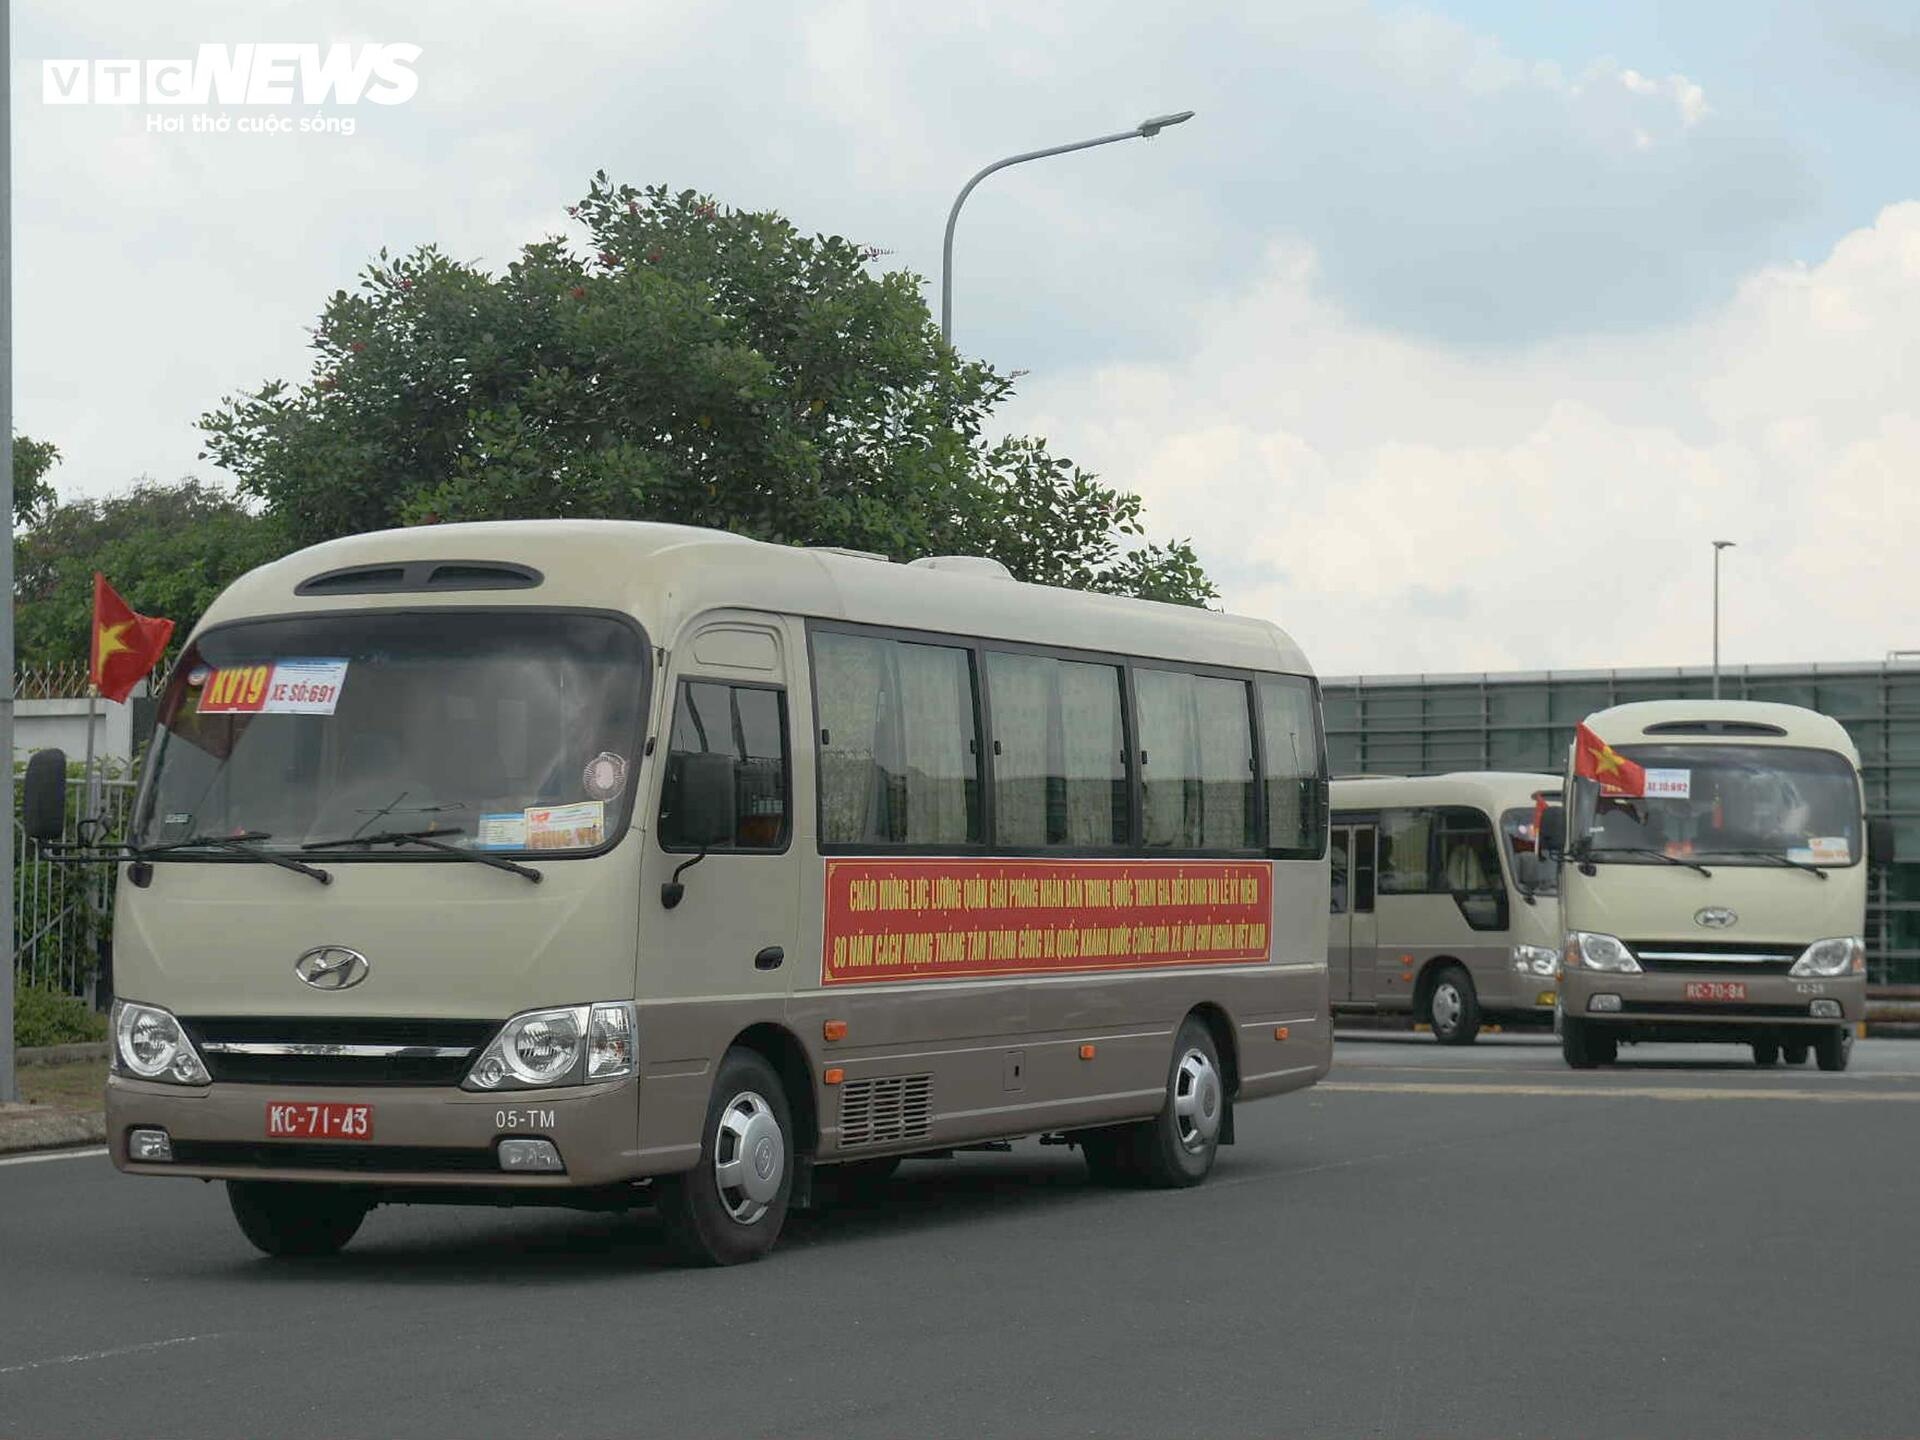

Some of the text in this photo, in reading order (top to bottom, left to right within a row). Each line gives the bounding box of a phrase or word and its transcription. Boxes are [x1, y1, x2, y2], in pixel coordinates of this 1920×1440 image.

[208, 666, 268, 704] KV19
[271, 684, 289, 701] XE
[849, 873, 877, 911] CHÀO
[879, 873, 909, 910] MỪNG
[911, 876, 929, 917] LỰC
[931, 876, 961, 917] LƯỢNG
[963, 873, 988, 912] QUÂN
[990, 869, 1008, 909] GIẢI
[1040, 873, 1064, 908] NHÂN
[1066, 873, 1083, 908] DÂN
[1084, 878, 1111, 908] TRUNG
[833, 935, 847, 969] 80
[848, 928, 875, 967] NĂM
[875, 927, 903, 966] CÁCH
[903, 932, 934, 971] MẠNG
[935, 924, 966, 963] THÁNG
[968, 924, 987, 961] TÁM
[1019, 923, 1042, 959] CÔNG
[1044, 922, 1055, 958] VÀ
[270, 1105, 368, 1135] KC-71-43
[495, 1110, 555, 1129] 05-TM
